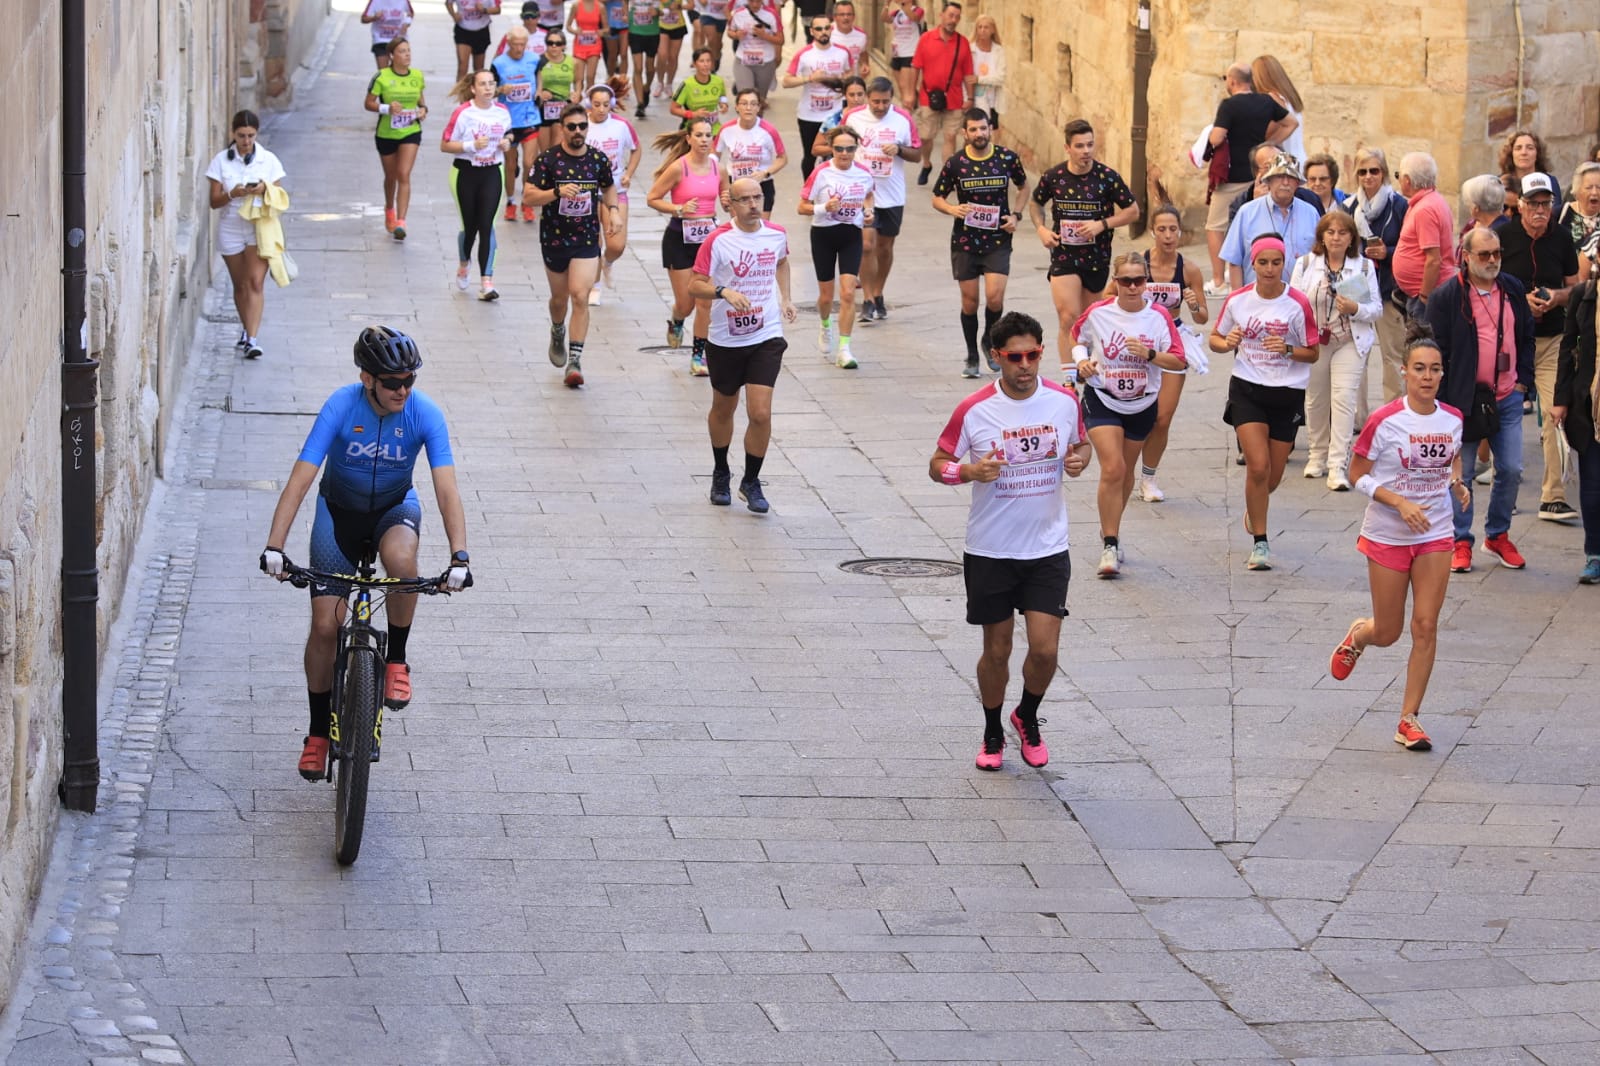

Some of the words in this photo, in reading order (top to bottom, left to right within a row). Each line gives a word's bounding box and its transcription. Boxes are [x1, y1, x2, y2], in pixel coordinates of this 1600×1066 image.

[871, 160, 883, 170] 51
[567, 201, 587, 210] 267
[973, 212, 992, 221] 480
[690, 226, 710, 237] 266
[1152, 292, 1168, 303] 79
[734, 314, 758, 328] 506
[1117, 379, 1134, 391] 83
[1409, 433, 1453, 444] bedunia
[1019, 436, 1040, 453] 39
[346, 441, 408, 461] DELL
[1419, 443, 1447, 458] 362
